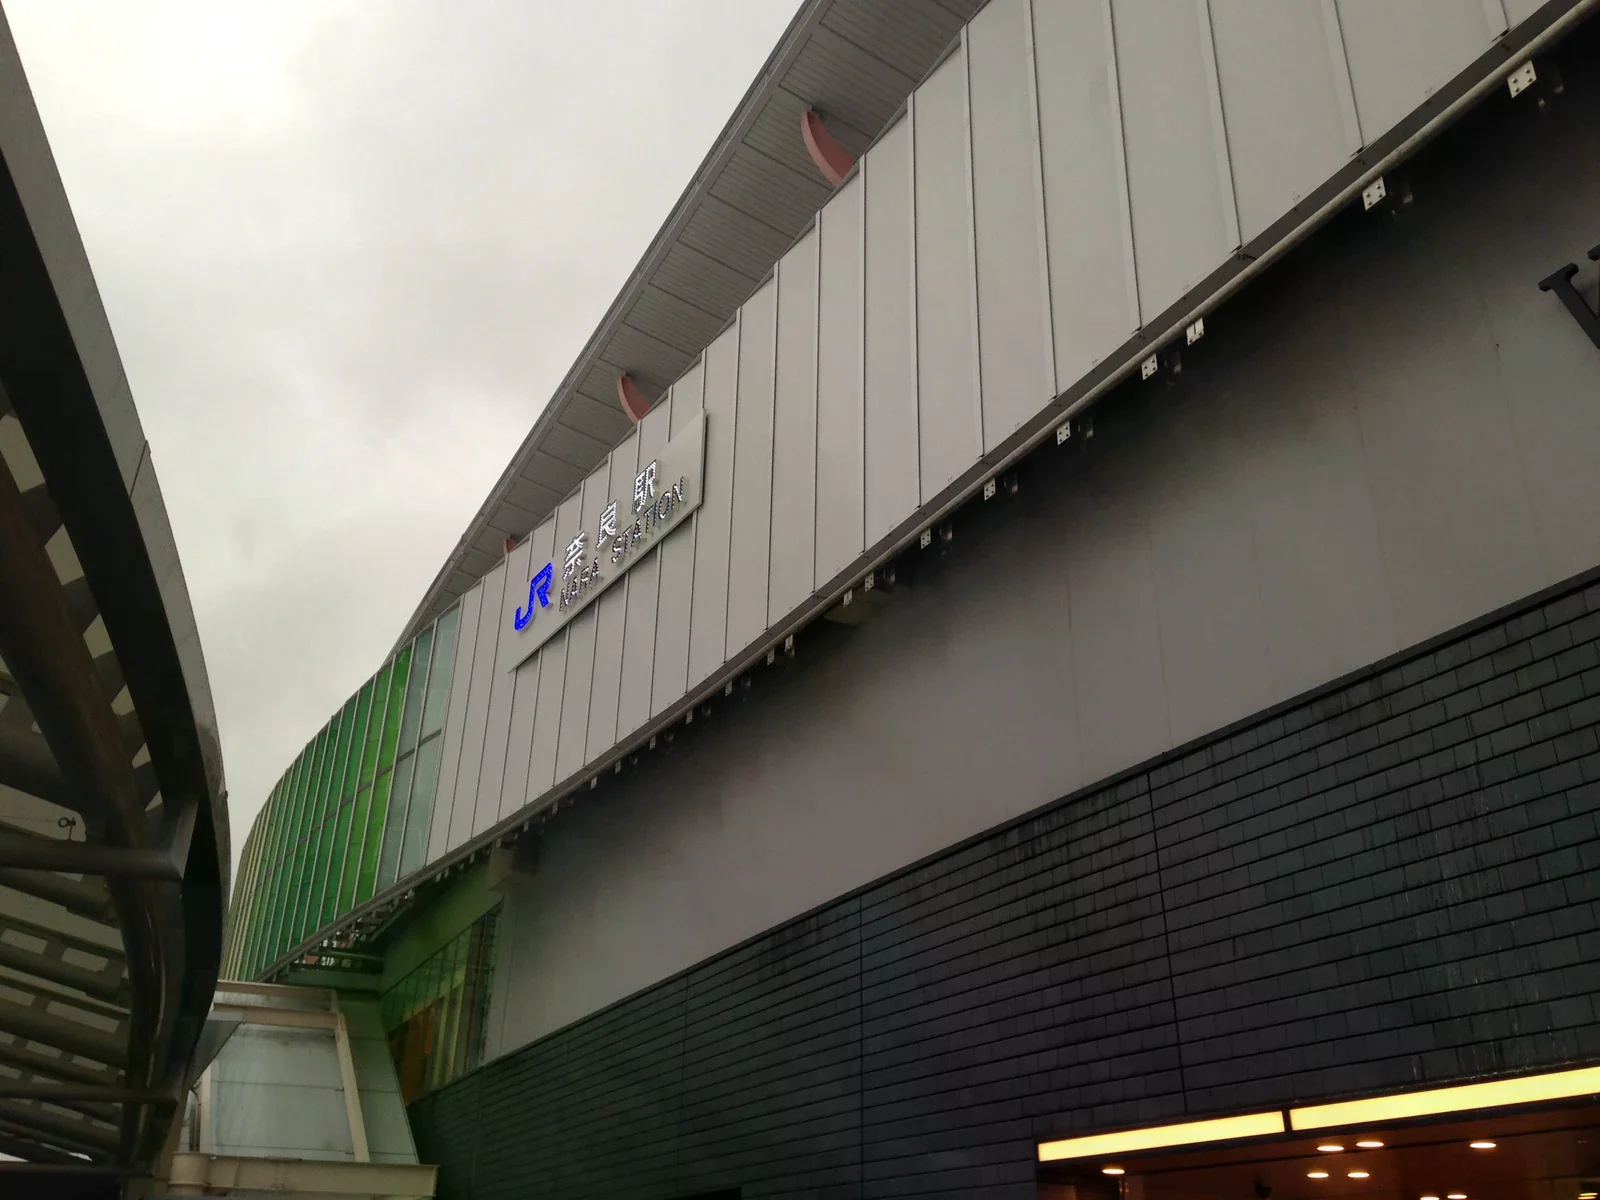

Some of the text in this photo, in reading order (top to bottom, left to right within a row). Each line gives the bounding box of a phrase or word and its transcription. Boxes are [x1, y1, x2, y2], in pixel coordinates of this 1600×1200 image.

[559, 476, 685, 612] NARA STATION
[562, 459, 657, 581] 奈良駅
[514, 563, 553, 631] JR
